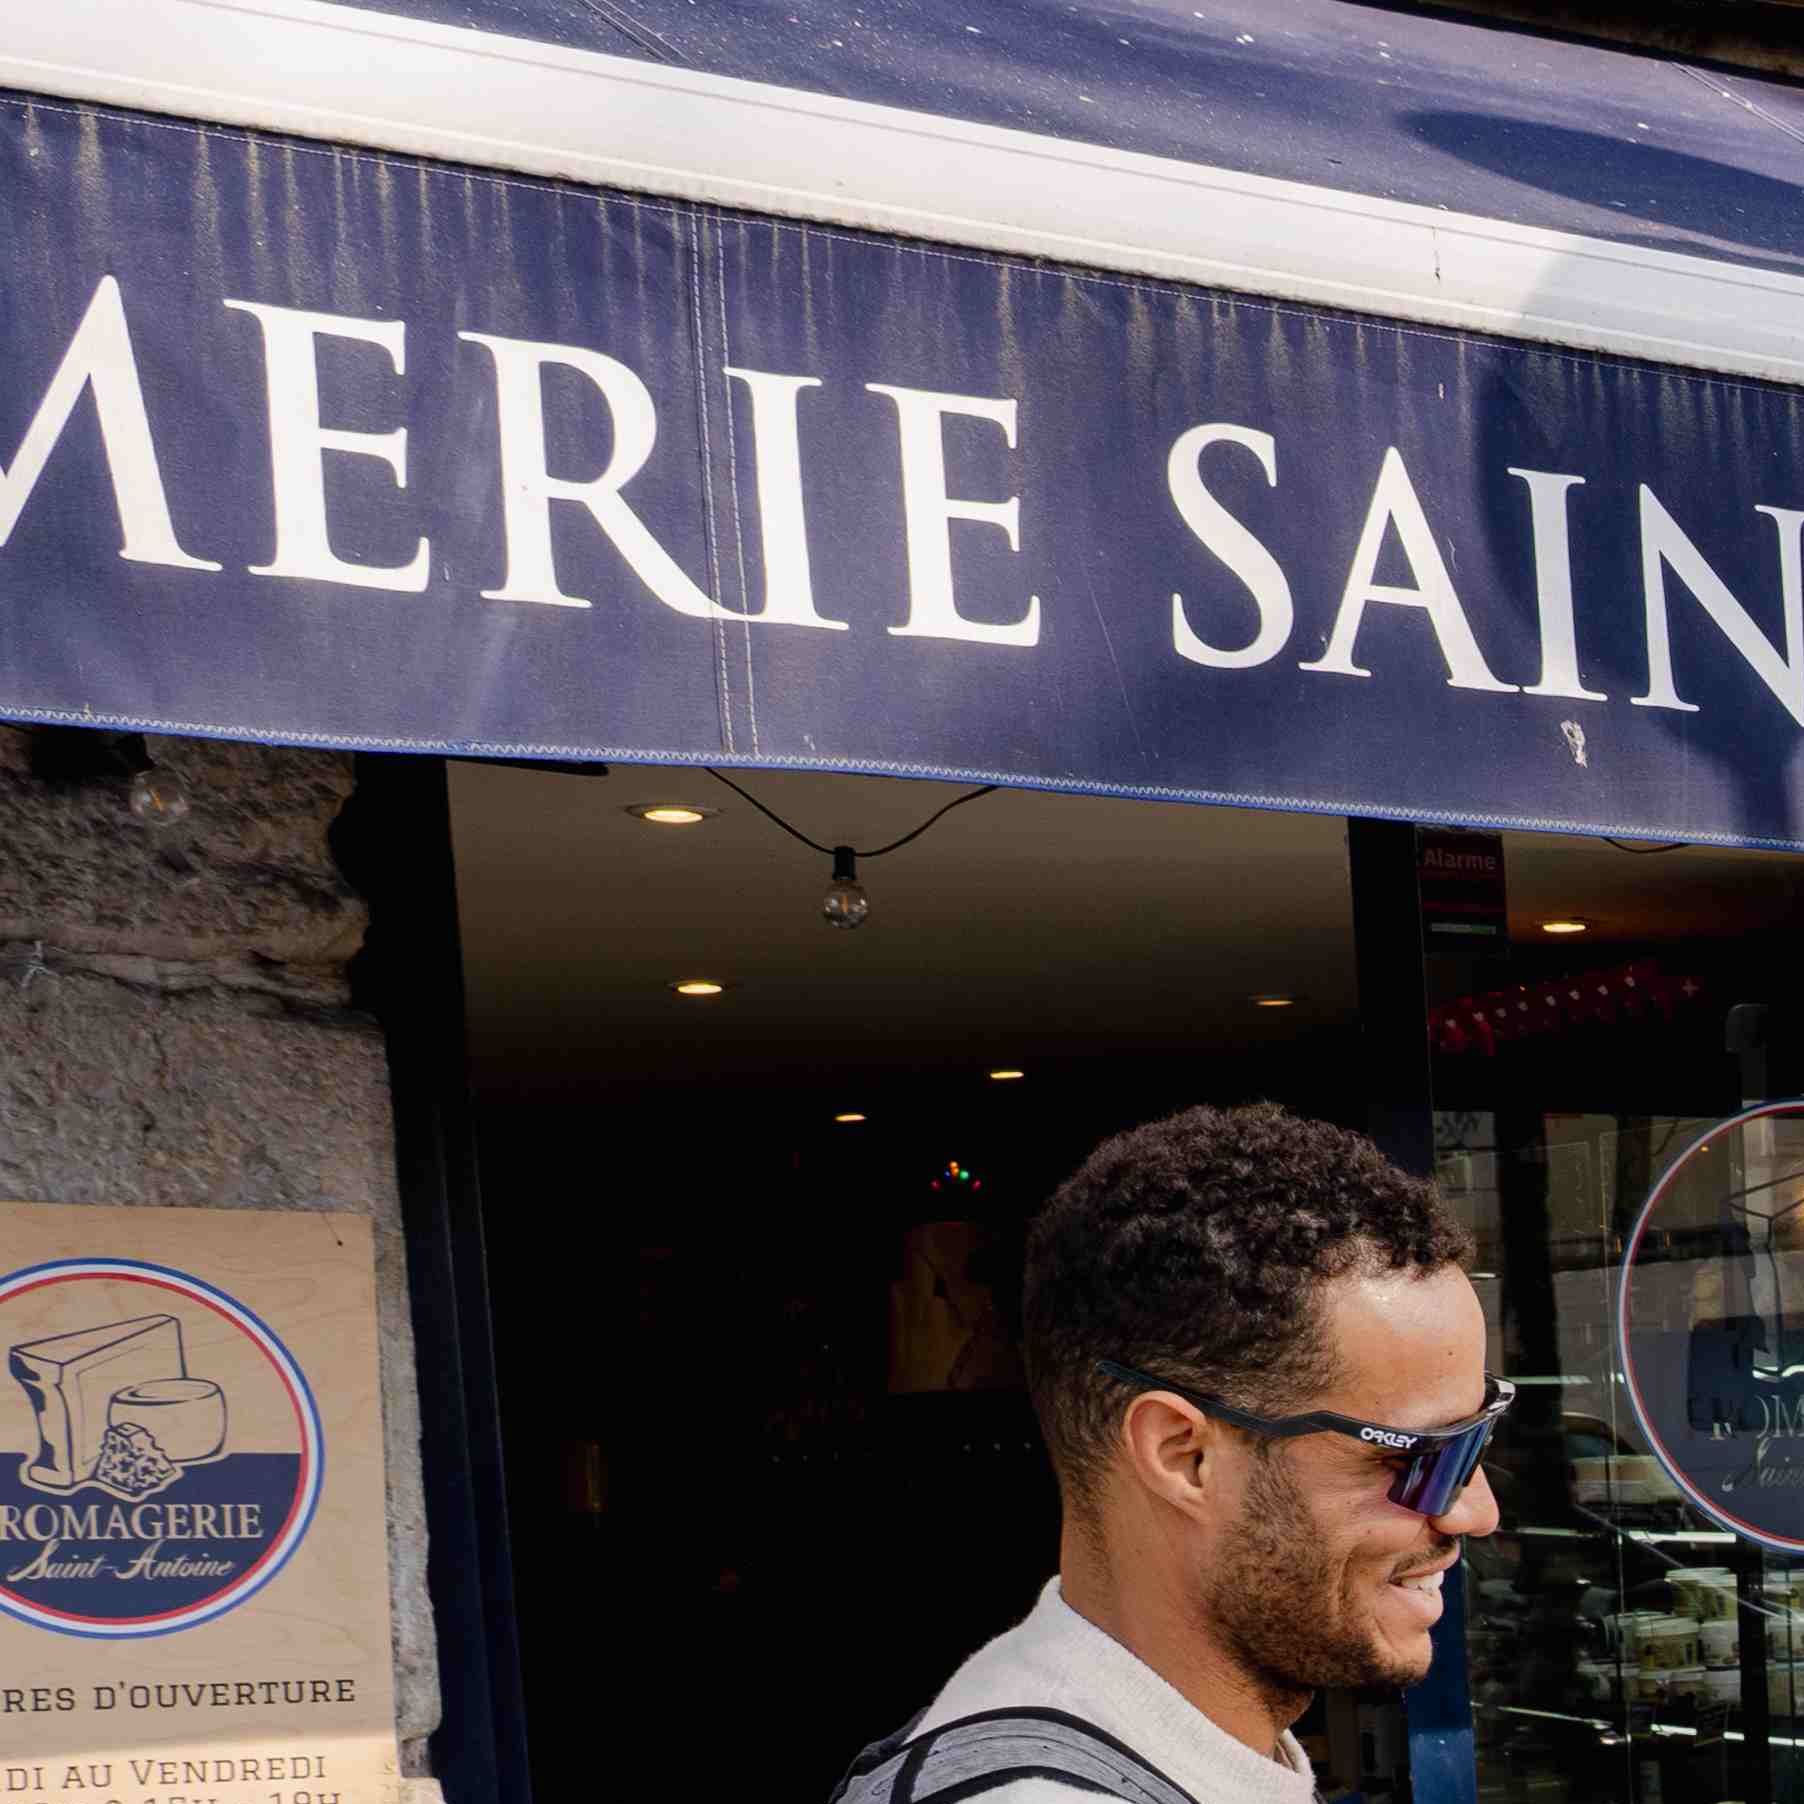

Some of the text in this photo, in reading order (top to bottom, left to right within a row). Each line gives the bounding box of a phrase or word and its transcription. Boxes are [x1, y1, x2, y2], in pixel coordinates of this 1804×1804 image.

[1423, 847, 1497, 872] Alarme
[1359, 1426, 1419, 1450] OAKLEY
[1, 1679, 357, 1714] RES D'OUVERTURE
[0, 1755, 328, 1792] DI AU VENDREDI
